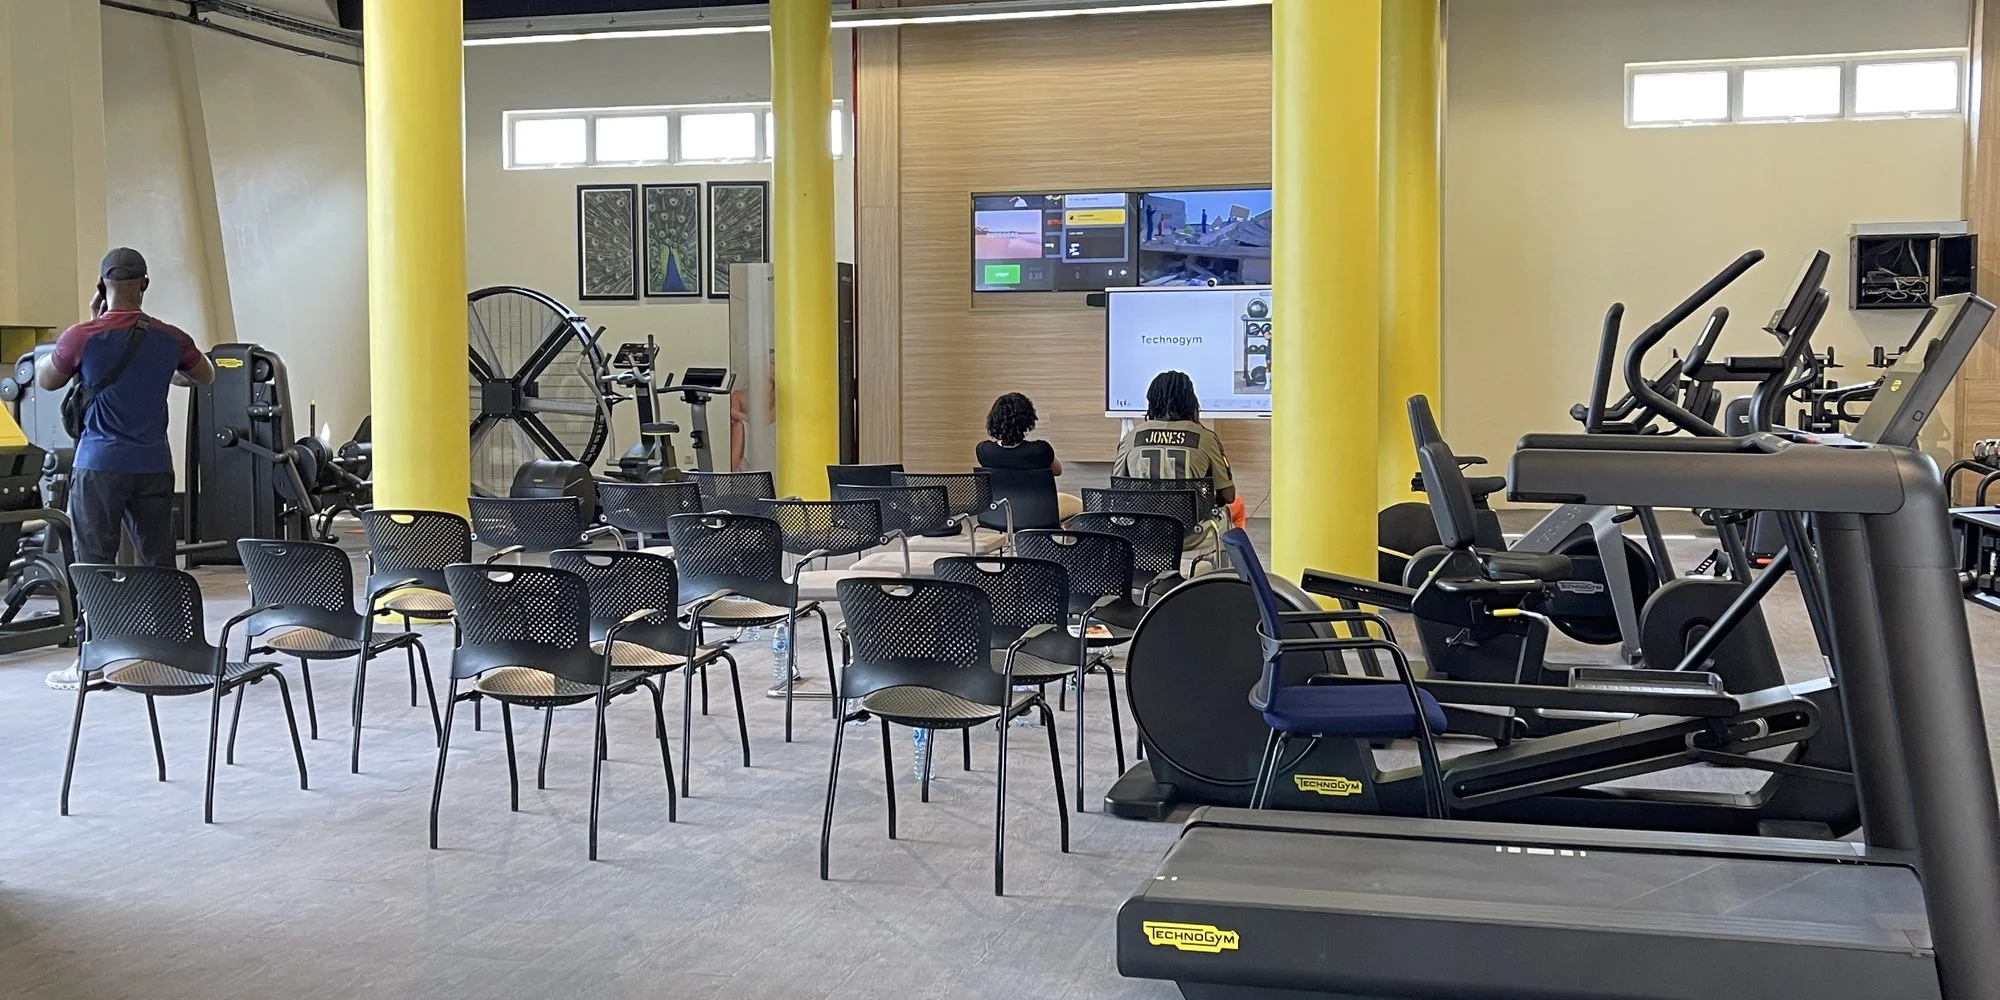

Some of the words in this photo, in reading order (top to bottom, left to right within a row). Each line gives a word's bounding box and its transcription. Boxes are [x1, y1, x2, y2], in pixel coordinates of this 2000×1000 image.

[1141, 335, 1203, 346] Technogym
[1145, 431, 1186, 445] JONES
[1140, 448, 1190, 480] 11
